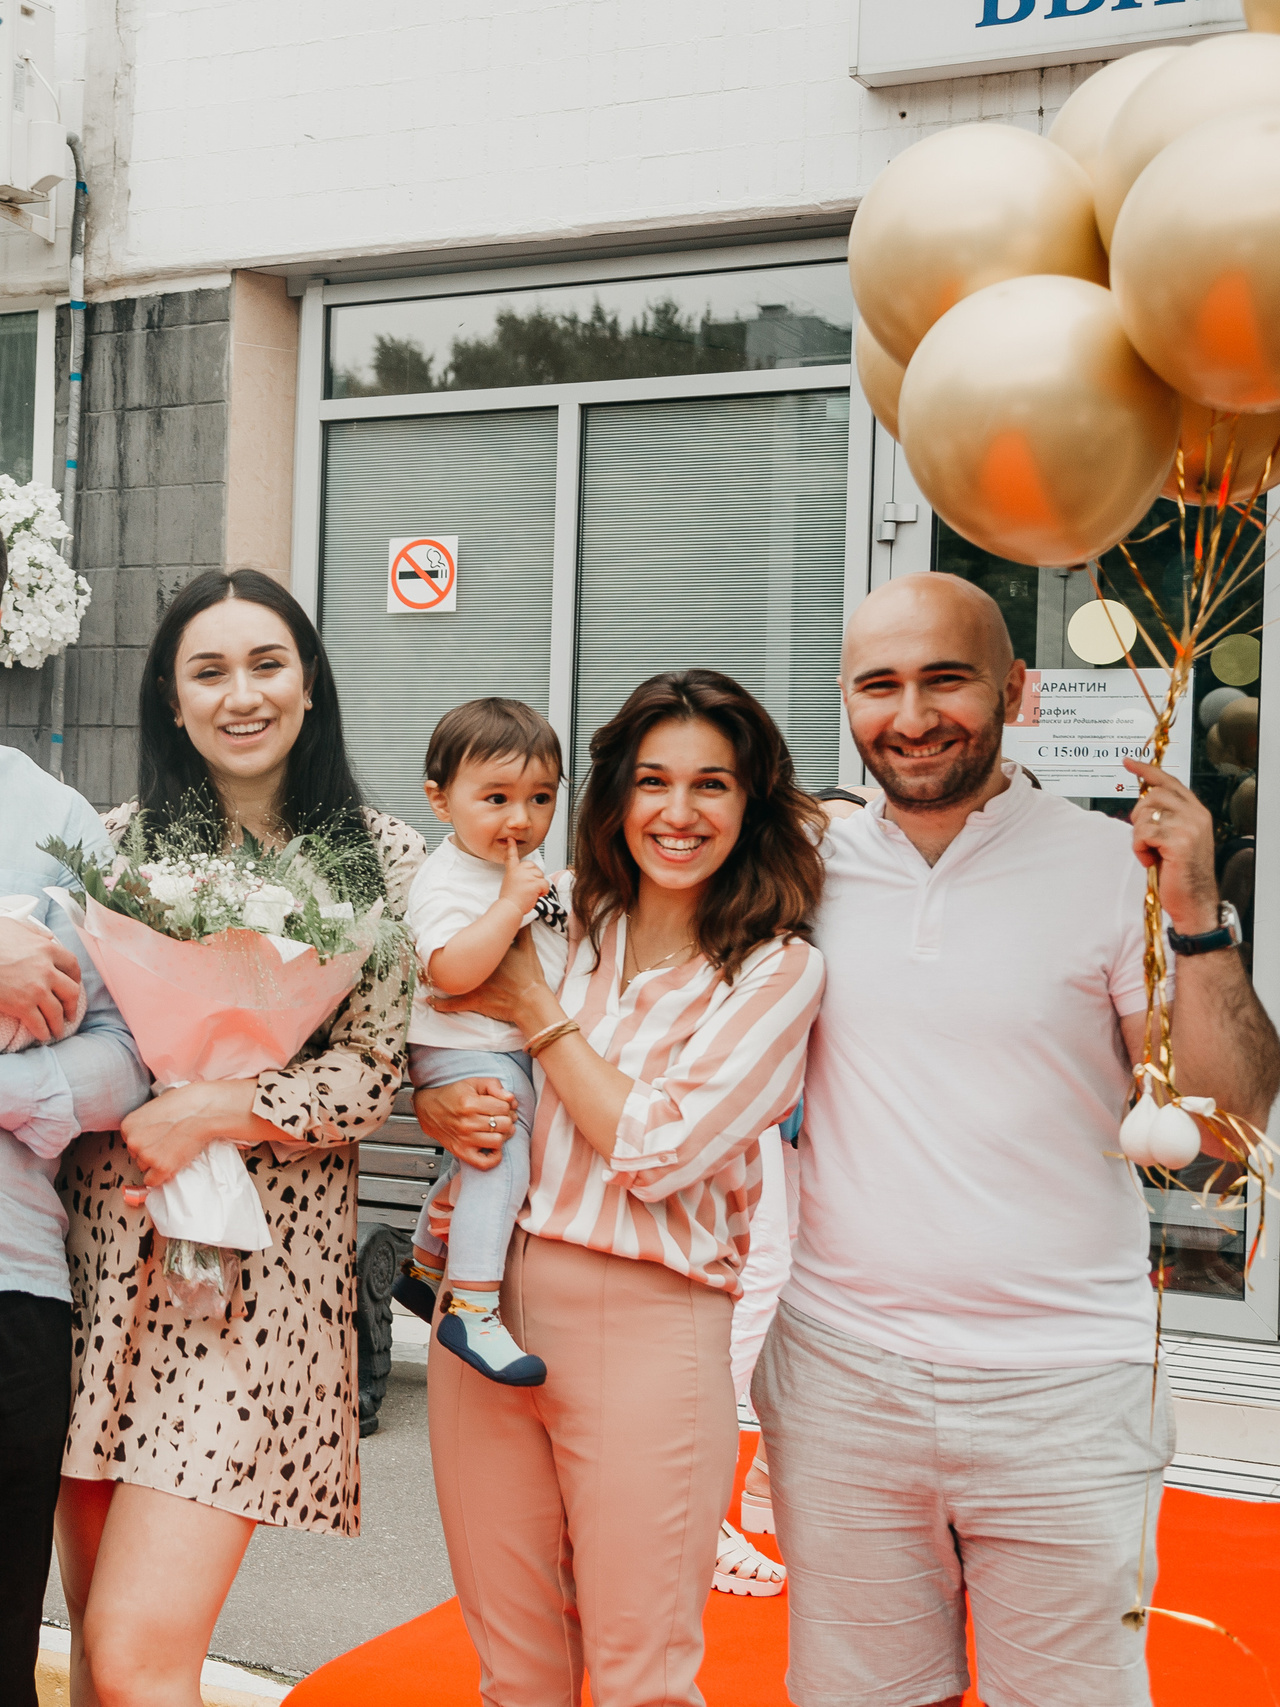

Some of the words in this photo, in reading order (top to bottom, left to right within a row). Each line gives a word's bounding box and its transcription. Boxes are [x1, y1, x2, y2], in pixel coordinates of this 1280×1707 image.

[1032, 682, 1107, 693] КАРАНТИН
[1033, 707, 1077, 717] График
[1038, 745, 1049, 757] С
[1054, 746, 1089, 757] 15:00
[1092, 749, 1109, 758] до
[1115, 746, 1150, 758] 19:00
